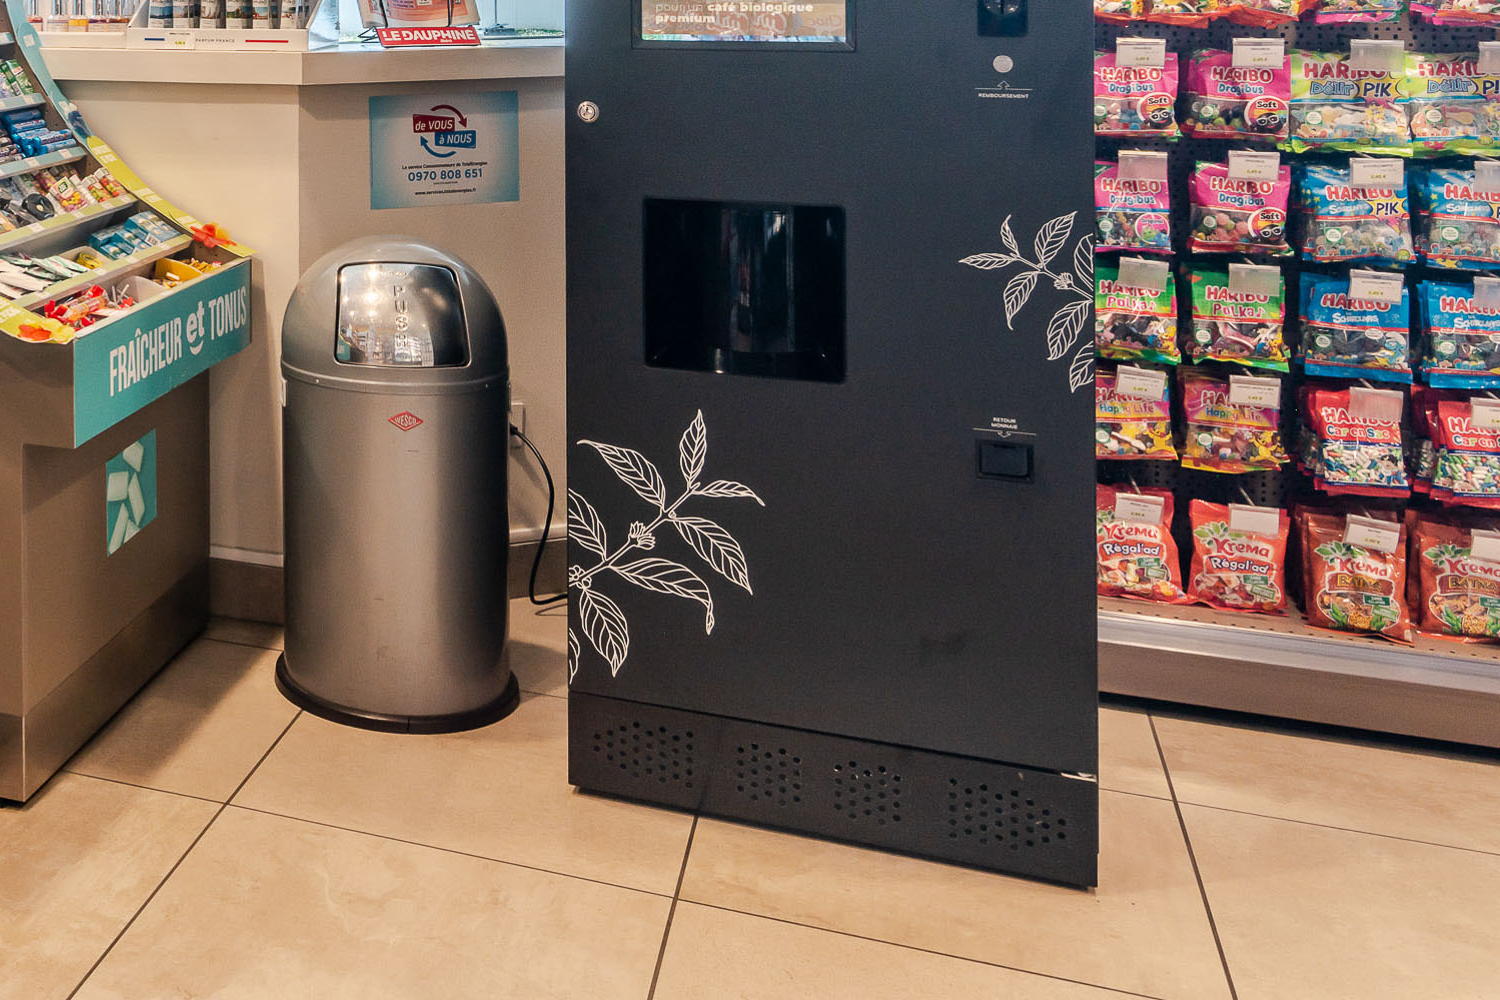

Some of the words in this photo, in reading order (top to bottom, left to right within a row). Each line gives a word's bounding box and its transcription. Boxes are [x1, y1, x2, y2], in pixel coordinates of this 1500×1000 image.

[707, 0, 736, 13] café
[739, 1, 815, 17] biologique
[654, 12, 716, 26] premium
[384, 29, 403, 42] LE
[1100, 65, 1162, 83] HARIBO
[1210, 65, 1274, 84] HARIBO
[1108, 82, 1155, 95] Dragibus
[1218, 82, 1264, 96] Dragibus
[1362, 80, 1392, 98] P!K
[977, 92, 1030, 100] REMBOURSEMENT
[1147, 96, 1169, 107] Soft
[1256, 99, 1278, 111] Soft
[414, 121, 427, 131] de
[428, 119, 453, 130] VOUS
[446, 133, 473, 144] NOUS
[407, 170, 437, 182] 0970
[440, 169, 462, 180] 808
[464, 167, 484, 179] 651
[1218, 193, 1266, 207] Dragibus
[1259, 210, 1281, 222] Soft
[1375, 201, 1400, 217] P!K
[109, 316, 183, 397] FRAÎCHEUR
[186, 300, 205, 343] et
[208, 285, 247, 341] TONUS
[1098, 402, 1130, 416] Happy
[1133, 402, 1156, 415] Life
[1205, 405, 1238, 421] Happy
[1240, 408, 1263, 422] Life
[393, 414, 419, 427] WESCO
[992, 416, 1017, 424] RETOUR
[1325, 425, 1346, 437] Car
[1346, 427, 1364, 438] en
[1365, 426, 1390, 439] Sac
[1102, 541, 1162, 557] Régal'ad
[1209, 555, 1271, 576] Régal'ad
